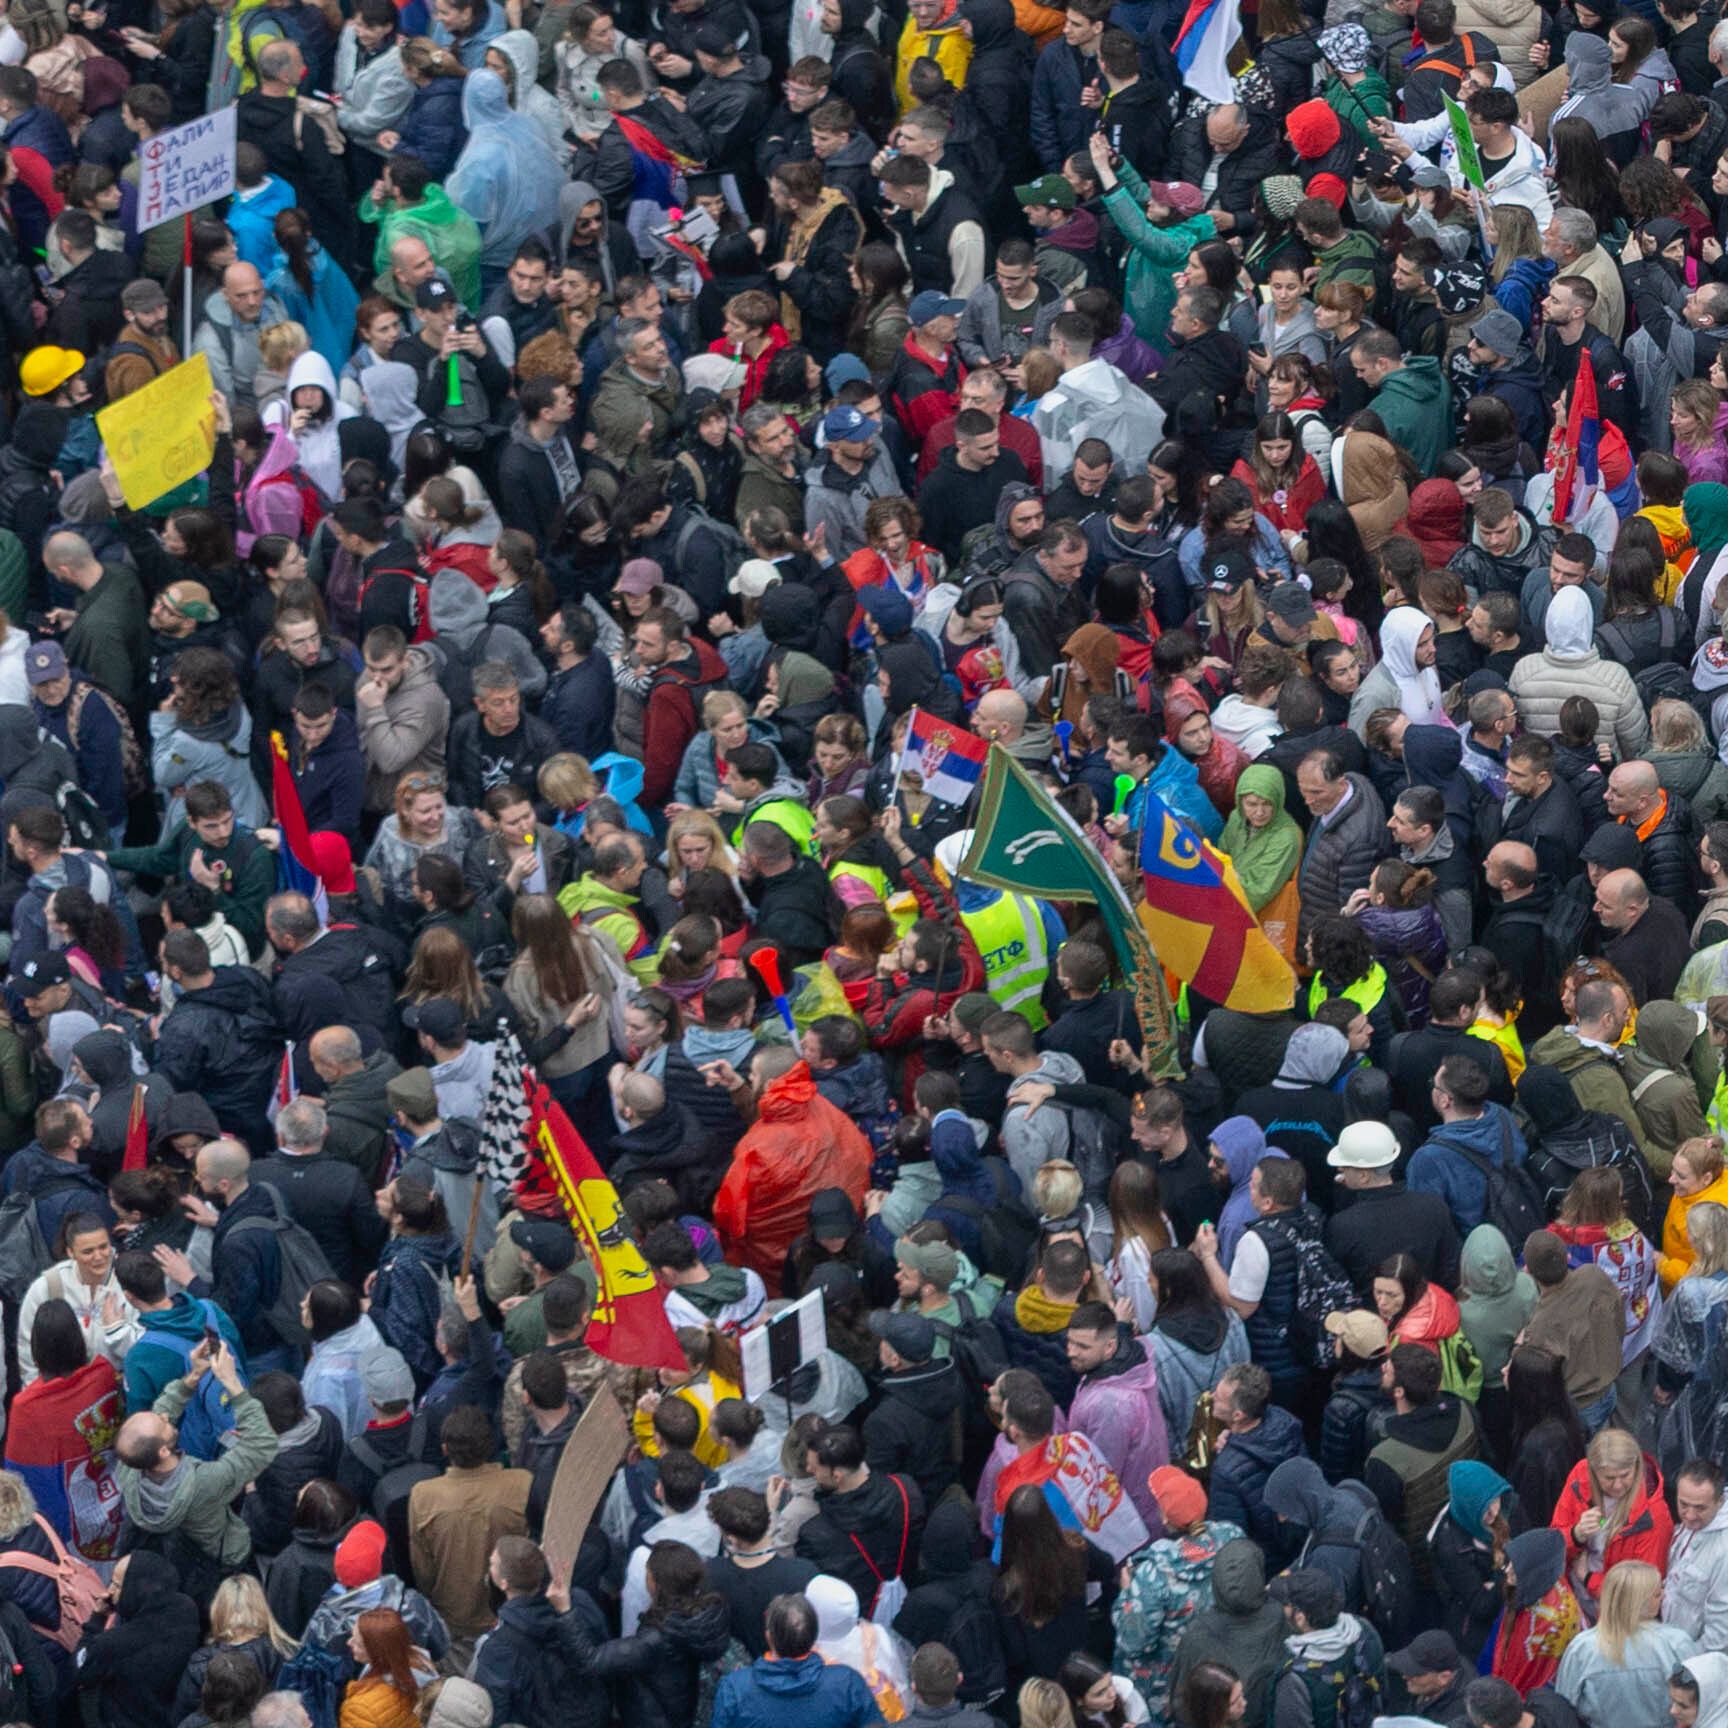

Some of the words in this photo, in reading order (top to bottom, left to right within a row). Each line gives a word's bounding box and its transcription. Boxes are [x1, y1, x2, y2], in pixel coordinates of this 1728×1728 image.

[145, 119, 214, 160] ФАЛИ
[146, 170, 230, 223] ПАПИР
[983, 940, 1024, 972] ЕТФ
